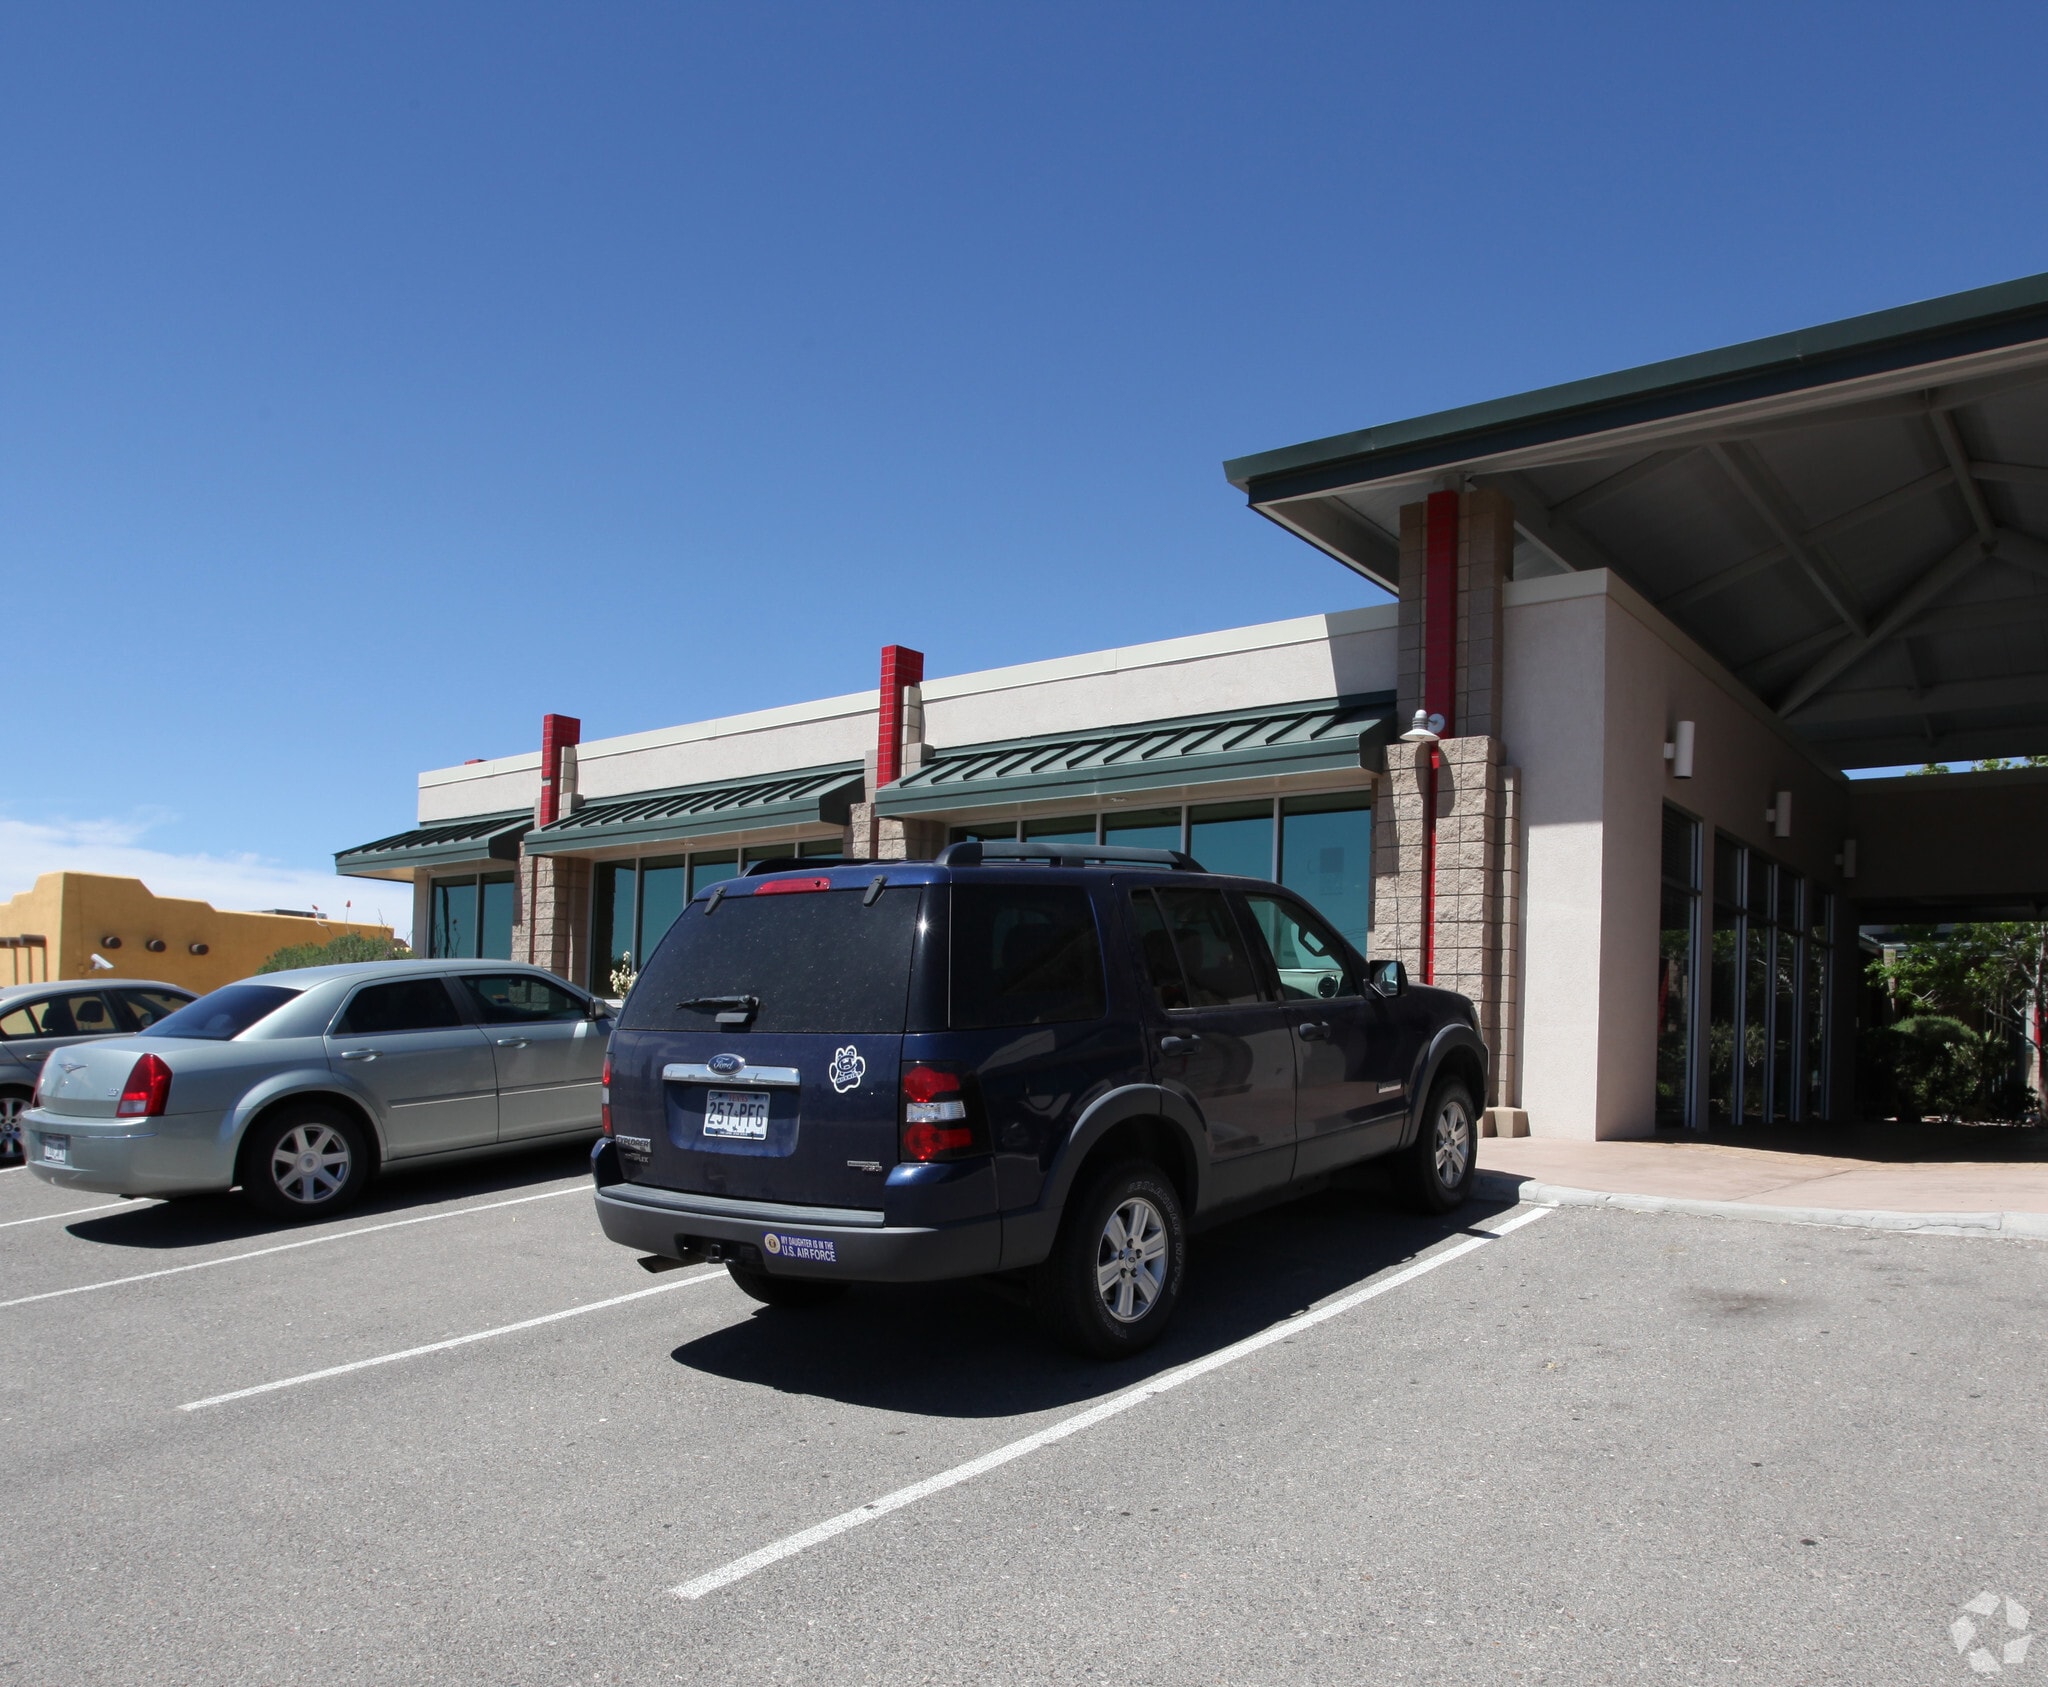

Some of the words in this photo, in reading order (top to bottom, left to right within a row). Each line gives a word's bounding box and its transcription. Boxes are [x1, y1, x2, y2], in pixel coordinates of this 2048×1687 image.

[713, 1057, 735, 1071] Ford
[616, 1136, 649, 1147] EXPLORER
[781, 1236, 788, 1245] MY
[788, 1237, 812, 1248] DAUGHTER
[824, 1241, 834, 1251] THE
[782, 1245, 796, 1257] U.S.
[797, 1247, 810, 1259] AIR
[810, 1248, 837, 1262] FORCE
